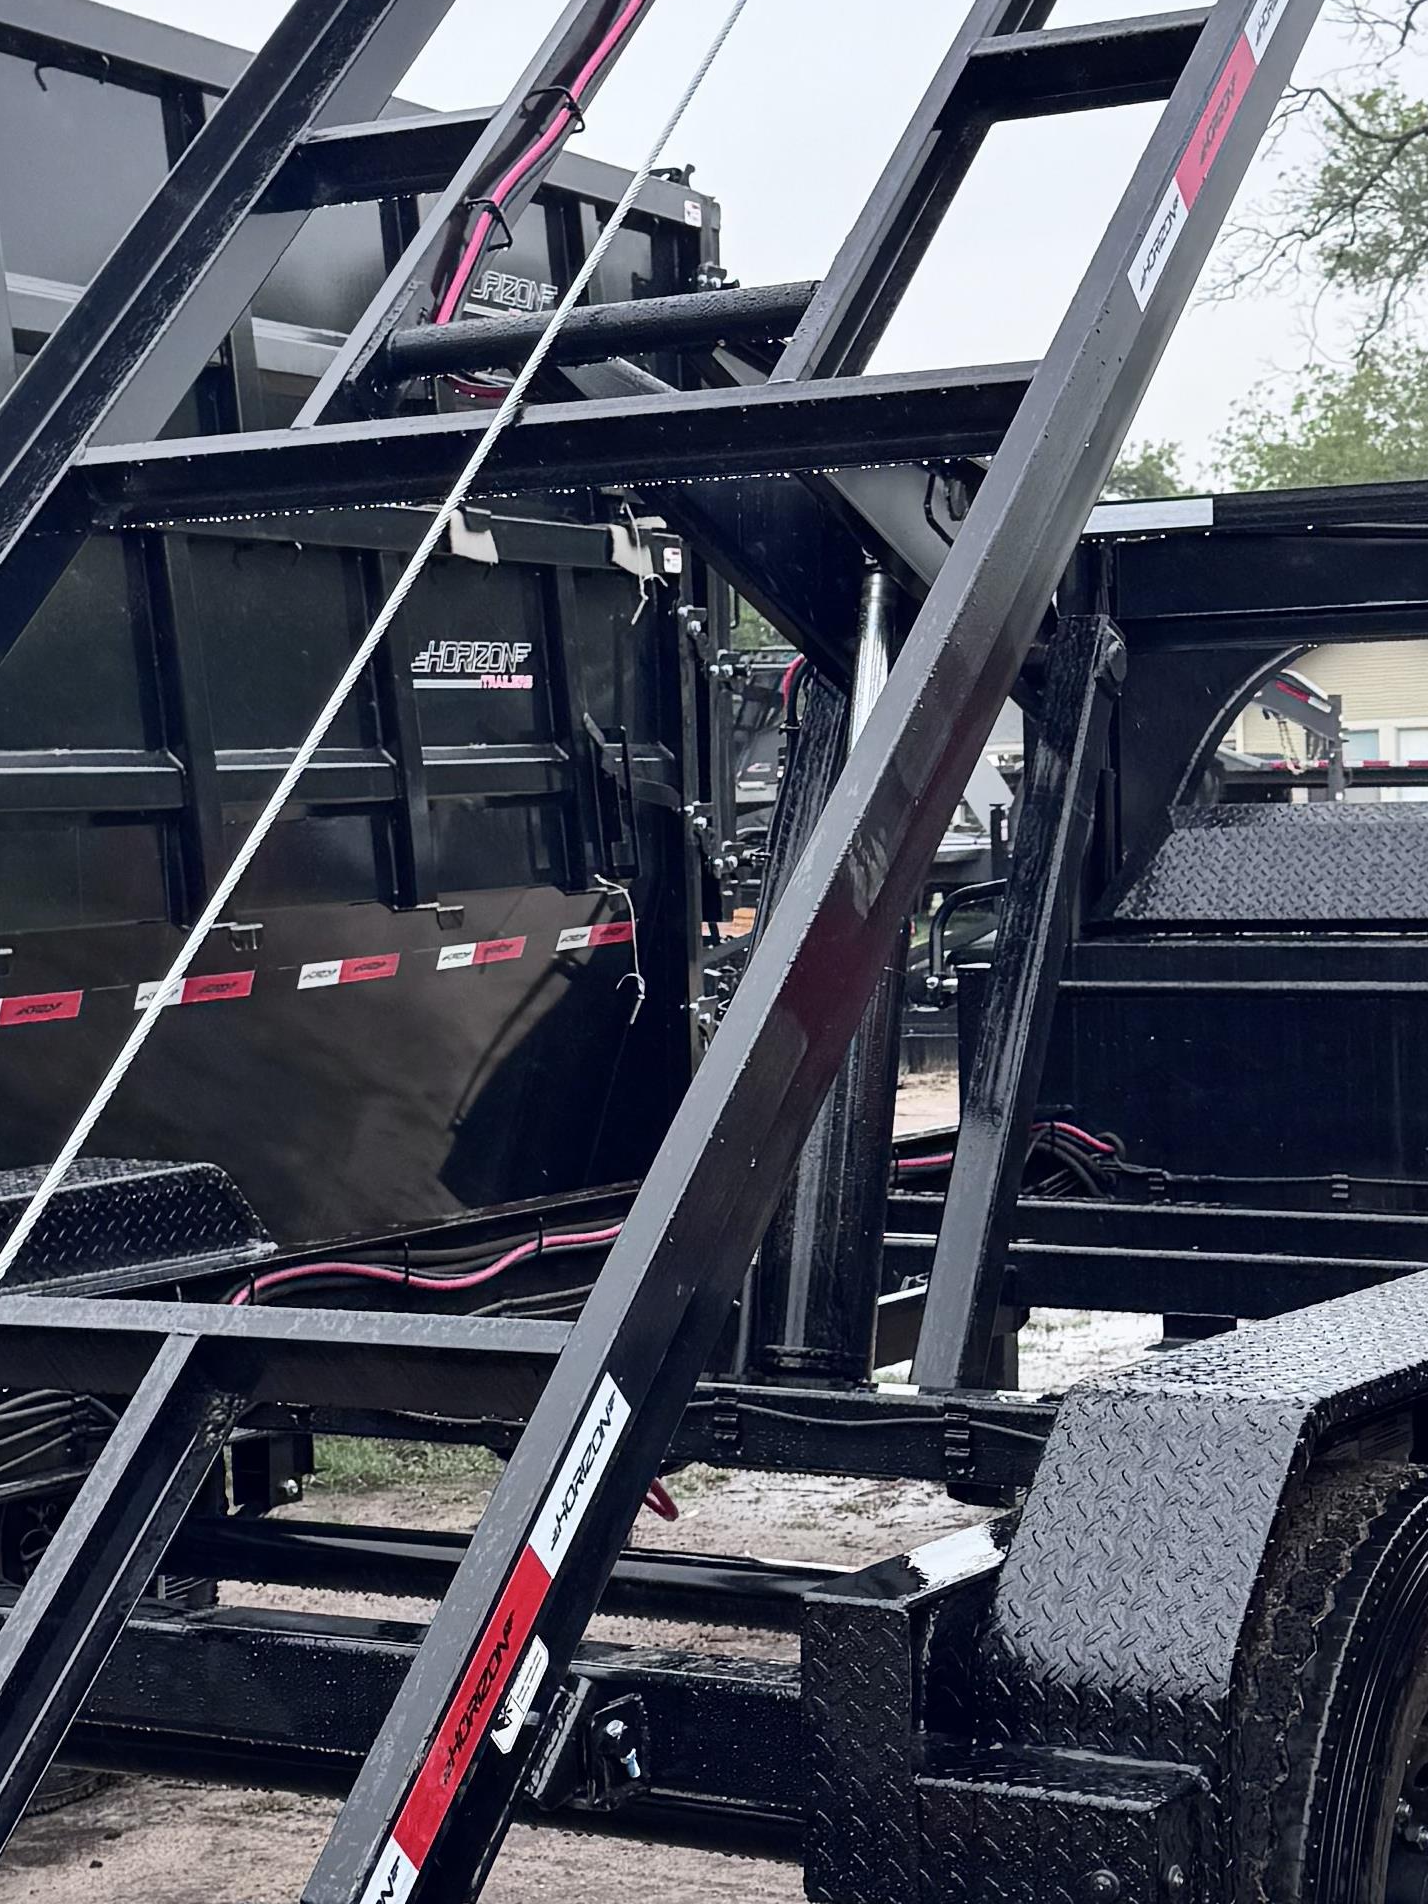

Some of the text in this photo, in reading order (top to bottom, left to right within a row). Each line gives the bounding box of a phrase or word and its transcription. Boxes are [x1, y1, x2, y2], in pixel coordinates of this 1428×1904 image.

[419, 639, 524, 674] HORIZON
[553, 1395, 614, 1540] HORIZON
[445, 1618, 513, 1776] HORIZON
